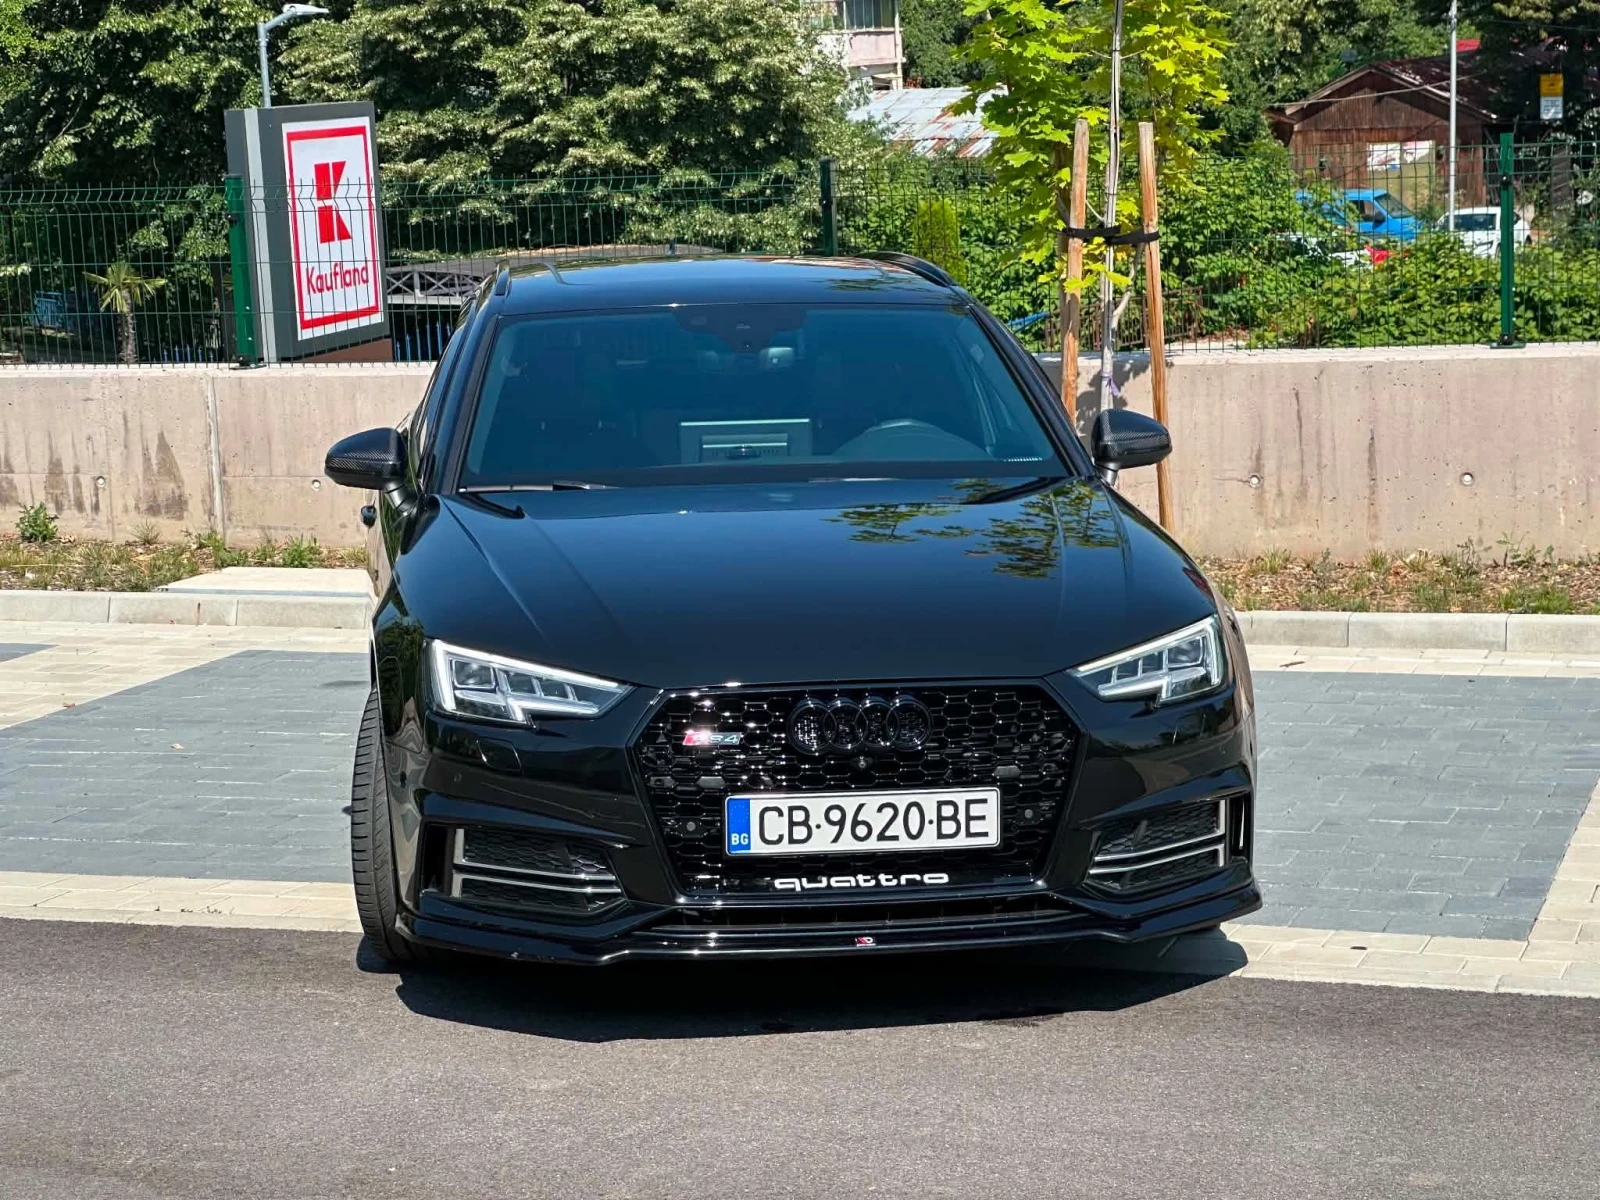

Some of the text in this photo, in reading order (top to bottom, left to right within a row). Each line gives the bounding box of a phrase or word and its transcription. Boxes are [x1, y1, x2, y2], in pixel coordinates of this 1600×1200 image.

[314, 161, 352, 243] K
[306, 259, 369, 294] Kaufland
[731, 833, 749, 846] BG
[774, 873, 949, 892] quattro
